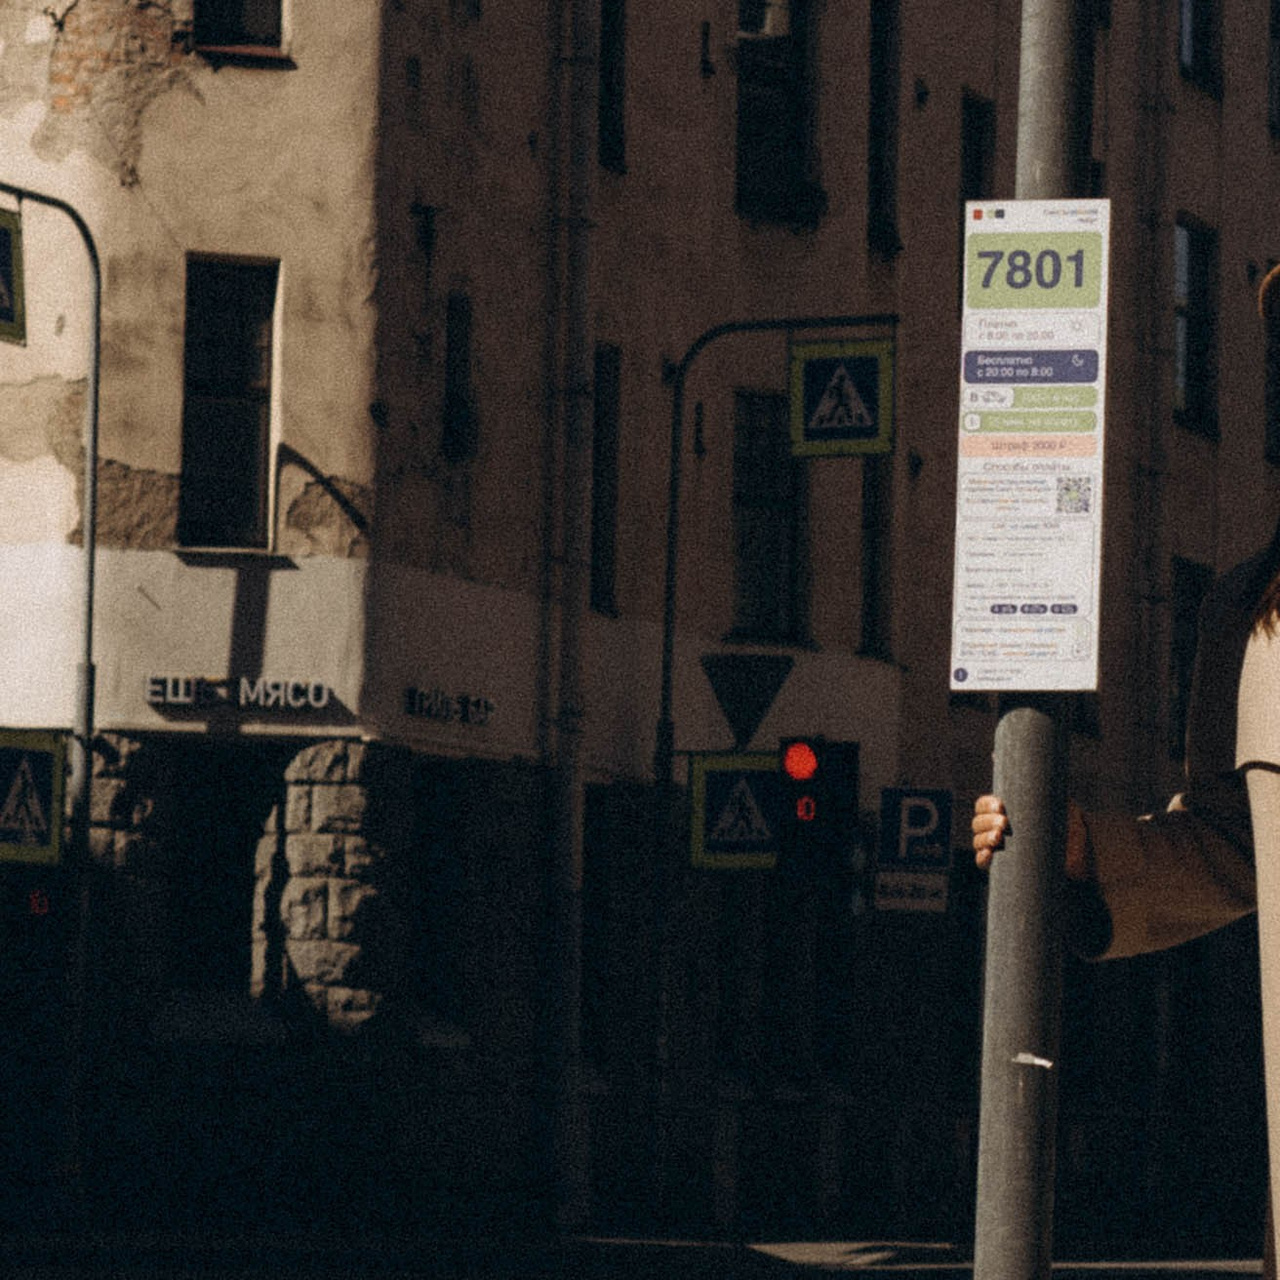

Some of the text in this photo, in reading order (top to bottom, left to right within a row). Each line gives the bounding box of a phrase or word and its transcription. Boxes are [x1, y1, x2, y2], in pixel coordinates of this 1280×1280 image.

[977, 249, 1085, 289] 7801
[977, 354, 1034, 365] Бесплатно
[238, 676, 330, 708] МЯСО
[899, 797, 939, 859] P
